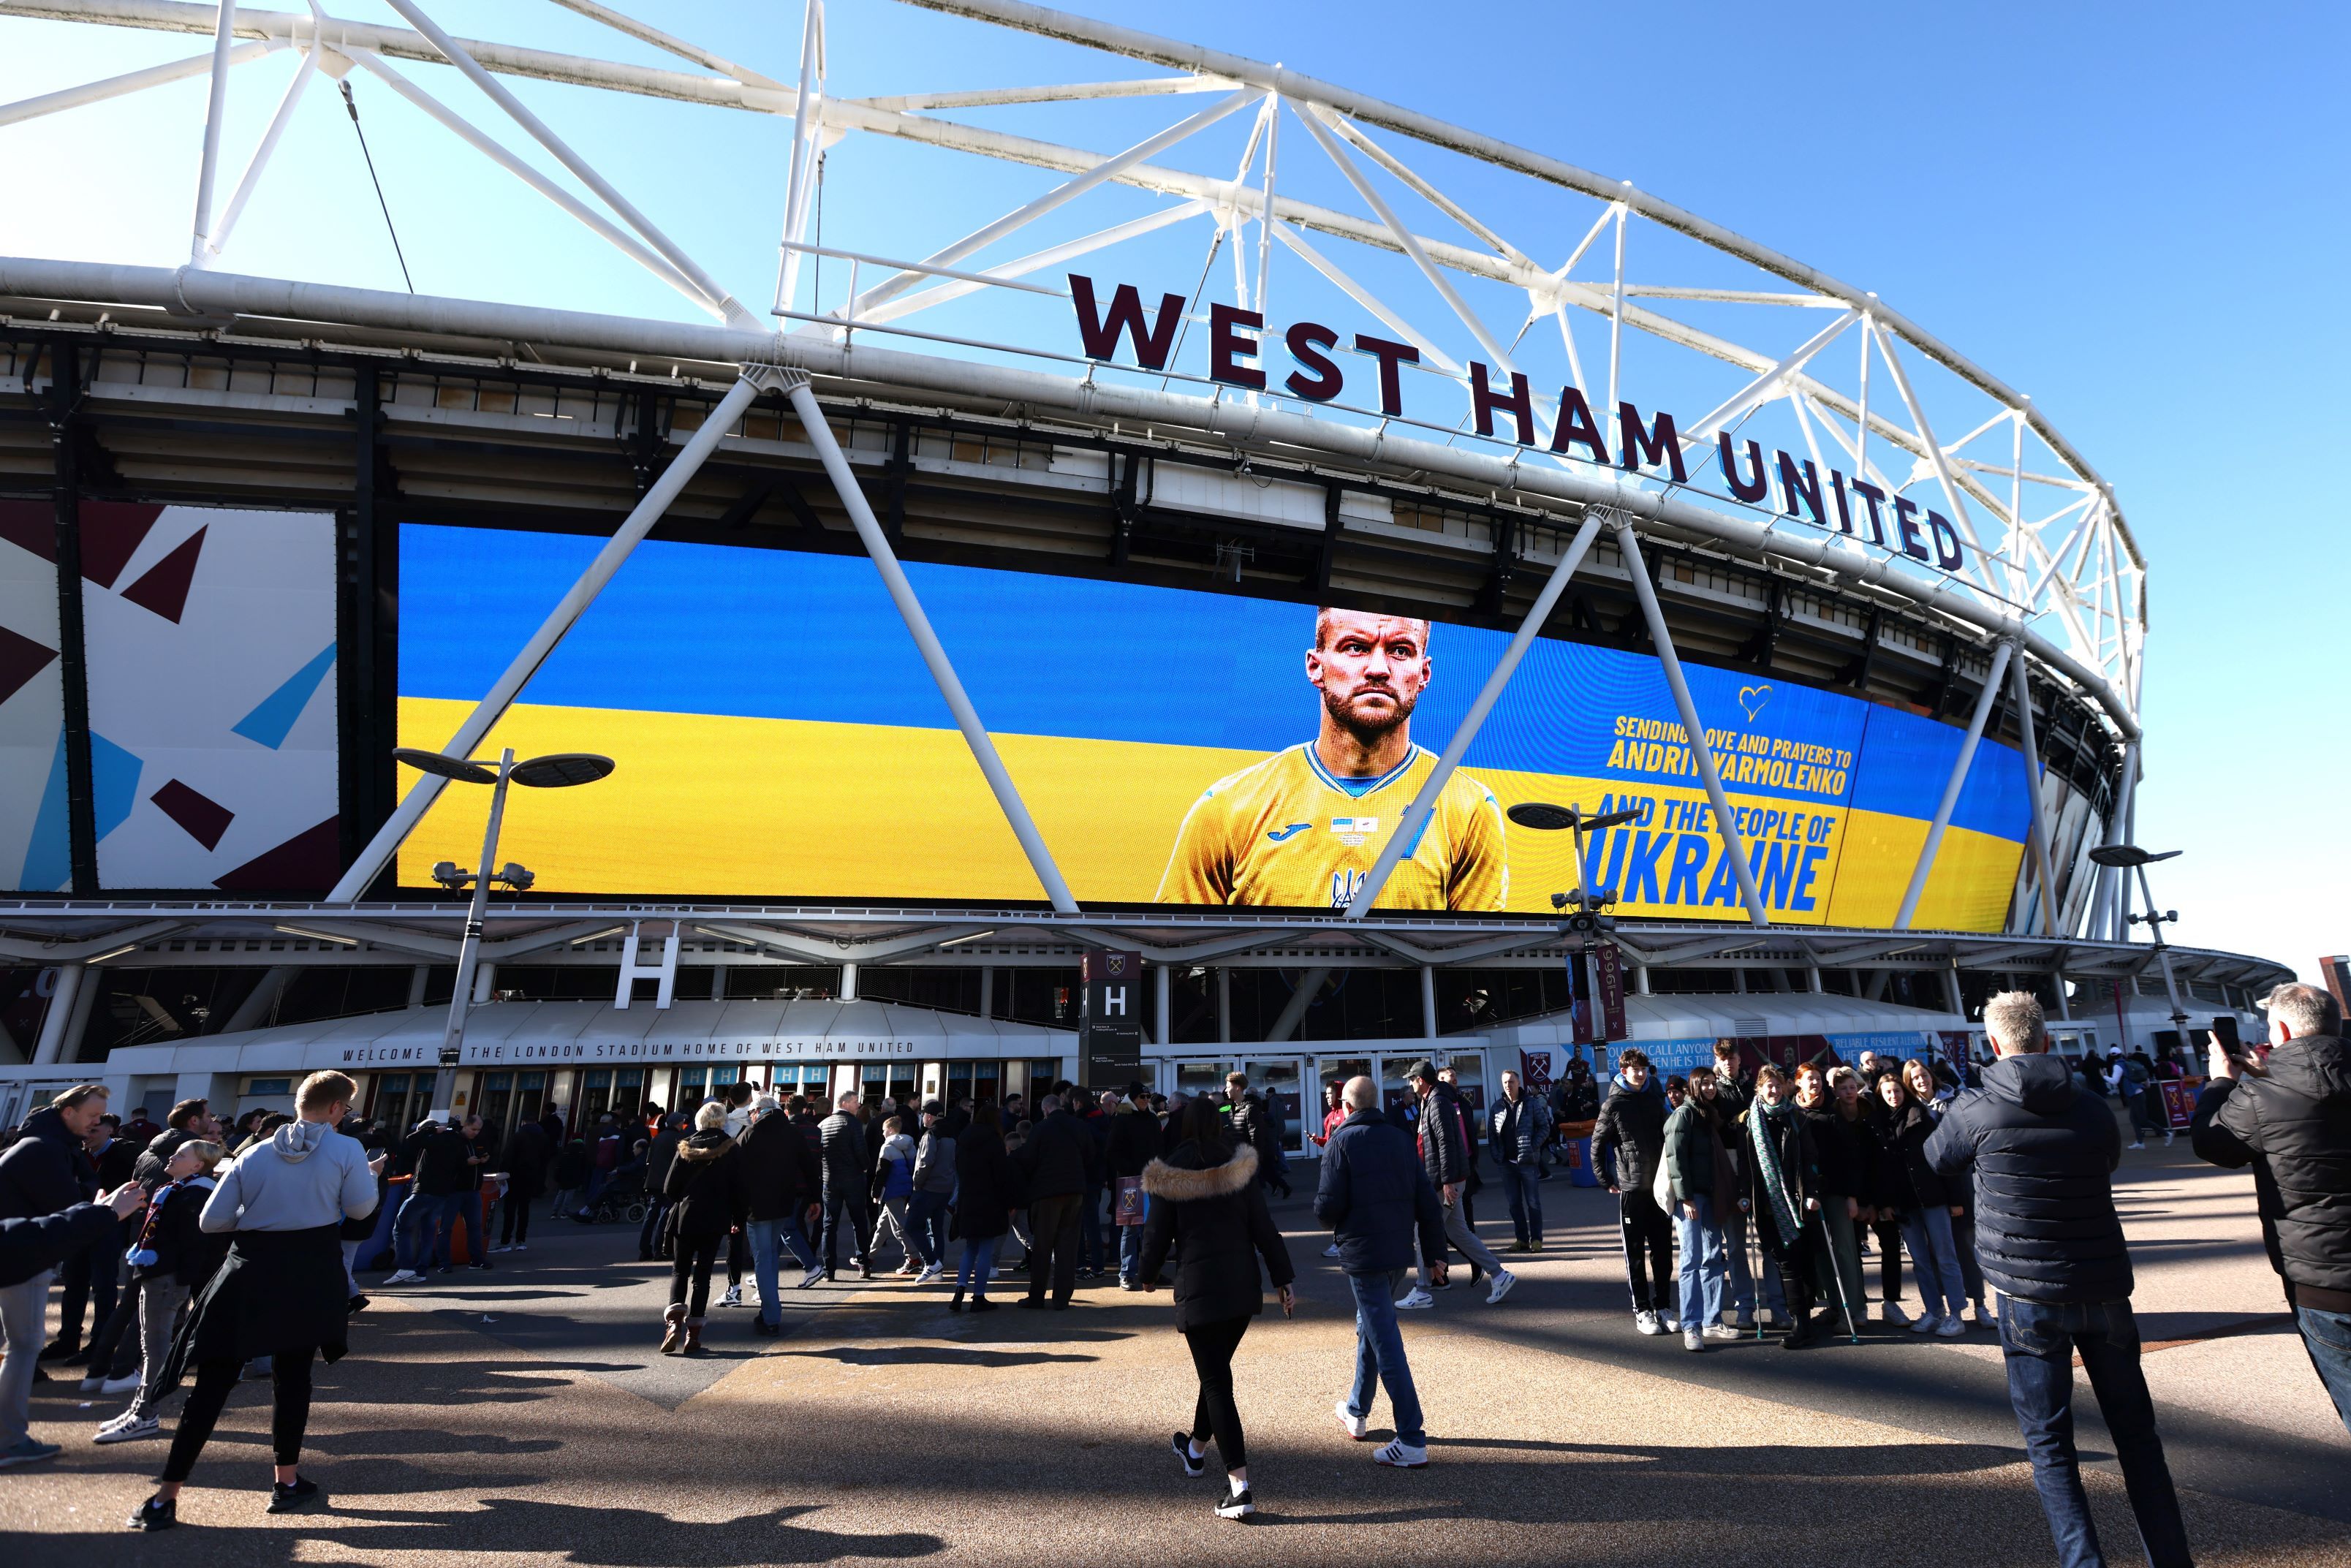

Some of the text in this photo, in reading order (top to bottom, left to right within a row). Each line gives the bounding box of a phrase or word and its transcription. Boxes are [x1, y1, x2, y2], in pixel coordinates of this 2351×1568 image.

[1067, 273, 1964, 571] WEST HAM UNITED
[1705, 728, 1737, 750] OVE
[1737, 733, 1769, 755] AND
[1771, 739, 1833, 765] PRAYERS
[1836, 749, 1852, 768] TO
[1713, 751, 1847, 795] YARMOLENKO
[1663, 799, 1714, 833] THE
[1807, 815, 1836, 844] OF
[1584, 827, 1829, 912] UKRAINE
[614, 936, 681, 1010] H
[1105, 986, 1126, 1015] H
[343, 1048, 423, 1061] WELCOME
[471, 1046, 501, 1058] THE
[515, 1045, 583, 1057] LONDON
[597, 1045, 673, 1056] STADIUM
[684, 1043, 727, 1055] HOME
[736, 1043, 752, 1054] OF
[762, 1042, 803, 1053] WEST
[815, 1042, 846, 1053] HAM
[858, 1042, 913, 1053] UNITED
[1606, 1046, 1623, 1058] OU
[1648, 1045, 1673, 1056] CALL
[1676, 1042, 1712, 1054] ANYONE
[1649, 1055, 1712, 1068] HEN HE IS THE
[690, 1071, 700, 1083] H
[721, 1070, 731, 1082] H
[782, 1069, 792, 1081] H
[811, 1069, 821, 1080] H
[871, 1067, 880, 1079] H
[898, 1067, 907, 1078] H
[955, 1066, 964, 1077] H
[983, 1066, 991, 1077] H
[393, 1076, 406, 1090] H
[496, 1076, 507, 1088] H
[528, 1075, 540, 1087] H
[594, 1072, 605, 1085] H
[625, 1072, 637, 1084] H
[1527, 1084, 1553, 1094] NBLE
